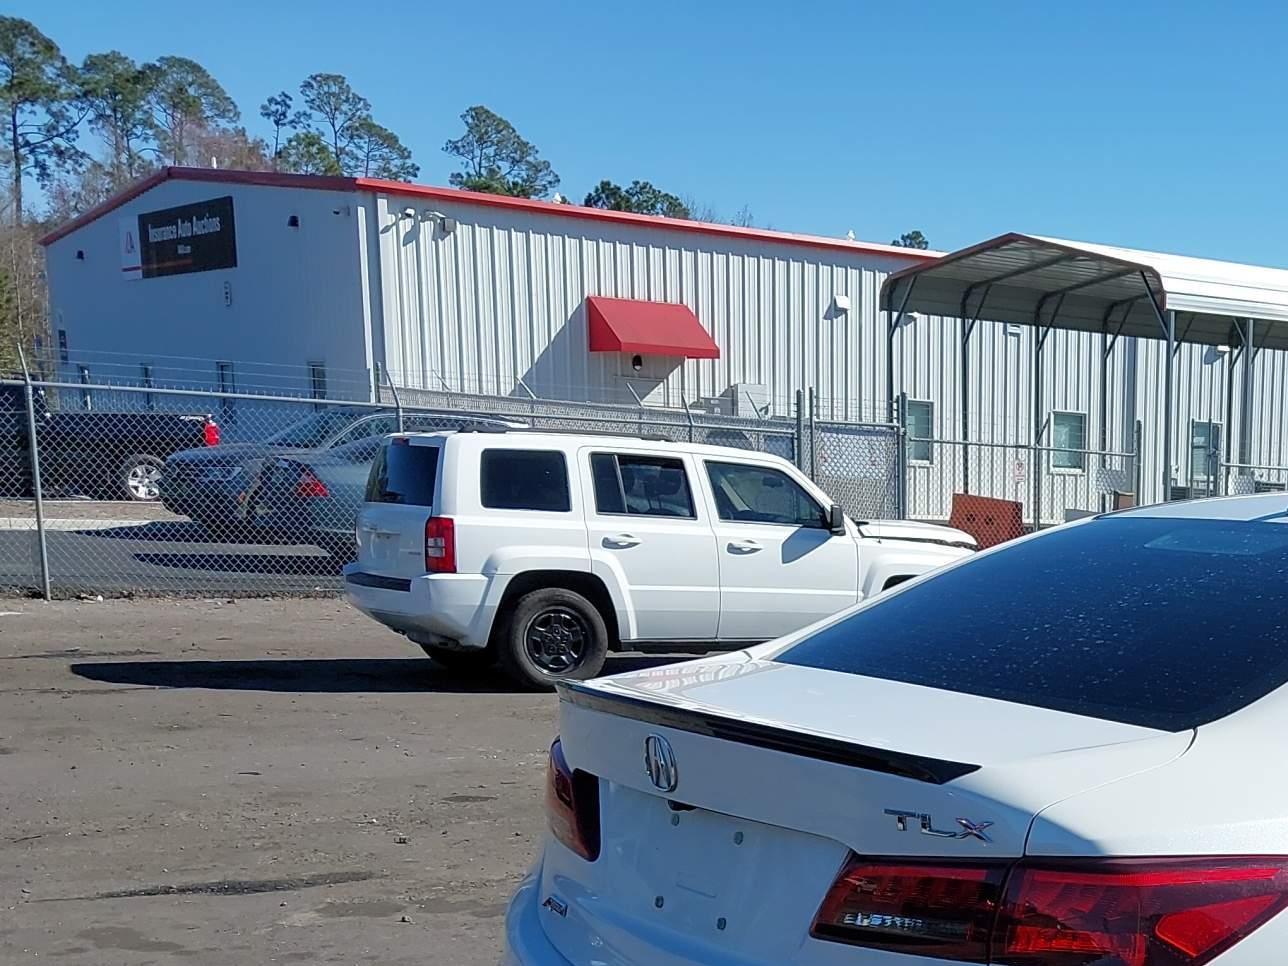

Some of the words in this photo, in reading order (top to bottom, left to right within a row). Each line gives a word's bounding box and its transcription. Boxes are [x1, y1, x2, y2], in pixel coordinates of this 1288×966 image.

[178, 218, 192, 239] Auto
[193, 212, 221, 236] Auctions
[883, 807, 995, 843] TLX
